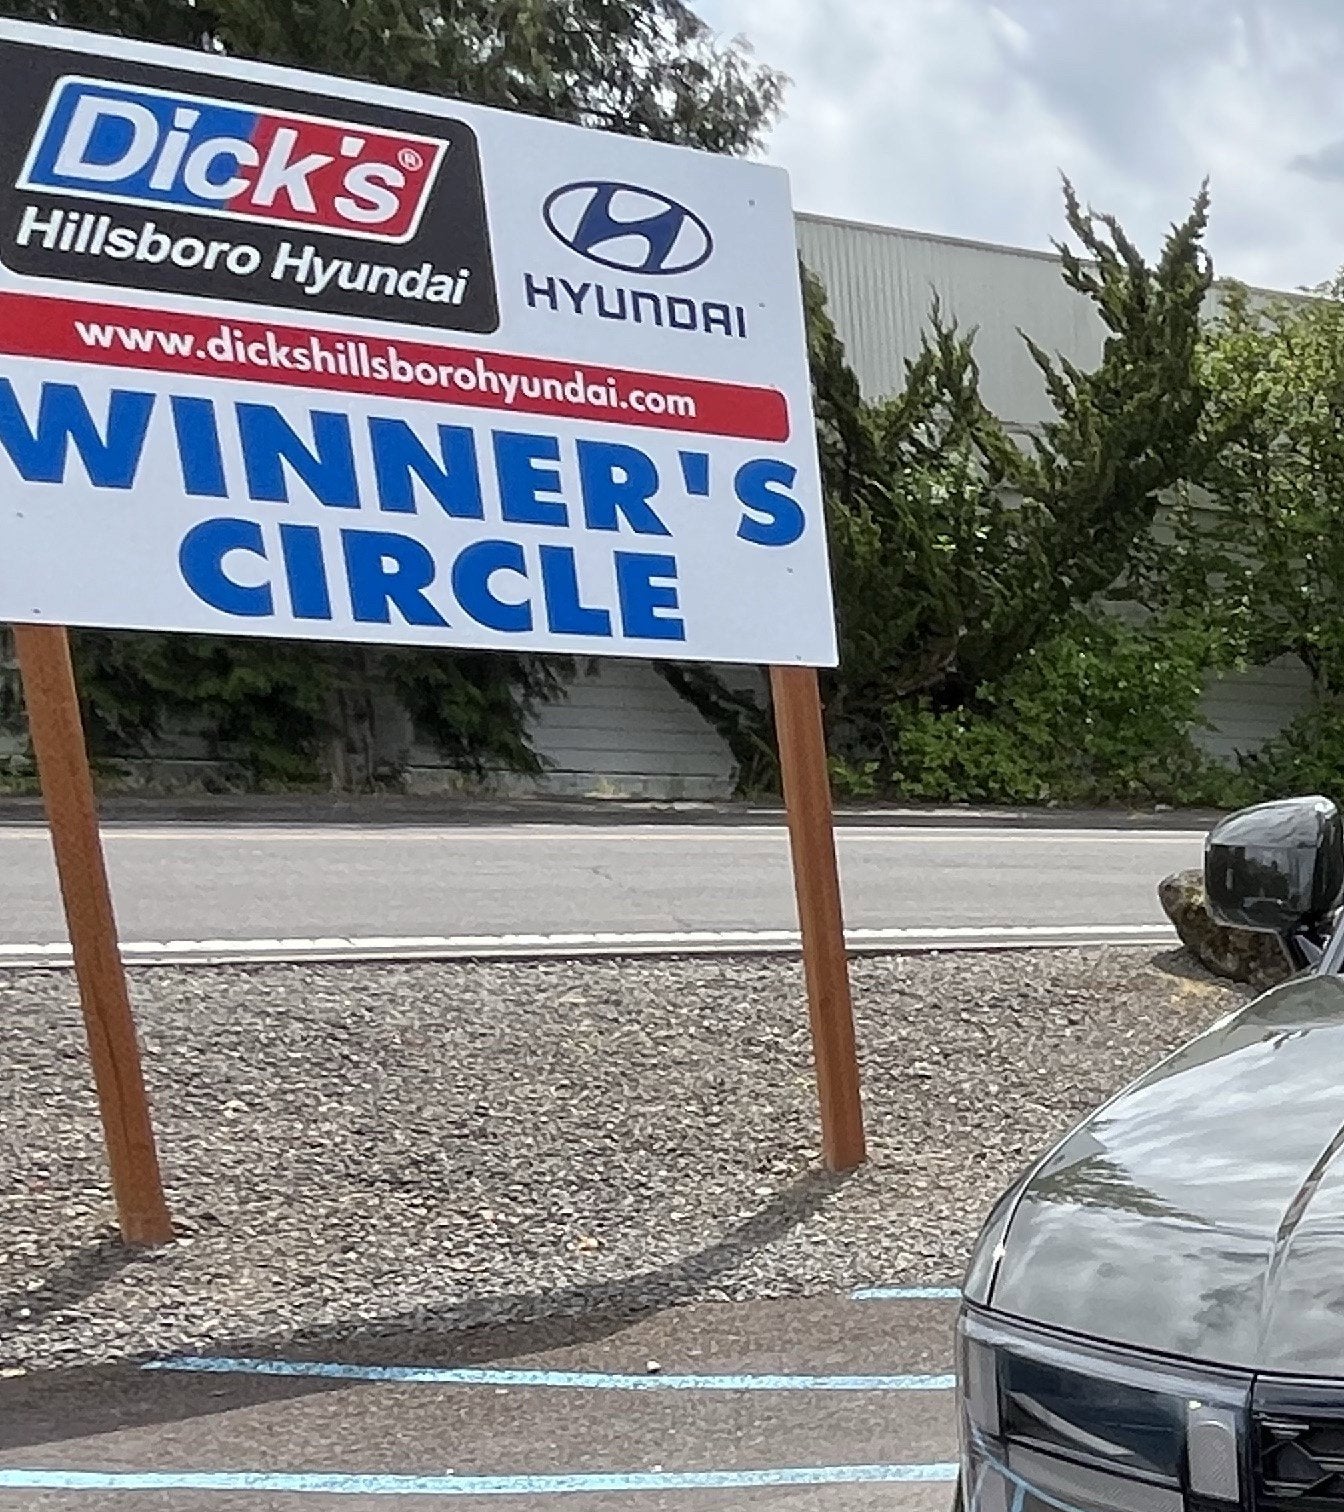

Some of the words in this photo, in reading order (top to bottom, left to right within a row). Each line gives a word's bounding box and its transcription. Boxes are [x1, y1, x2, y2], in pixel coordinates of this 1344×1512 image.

[53, 94, 406, 225] Dick's
[15, 205, 261, 275] Hillsboro
[271, 242, 471, 304] Hyundai
[523, 272, 748, 338] HYUNDAI
[75, 317, 697, 419] www.dickshillsborohyundai.com
[0, 377, 806, 547] WINNER'S
[178, 517, 687, 642] CIRCLE
